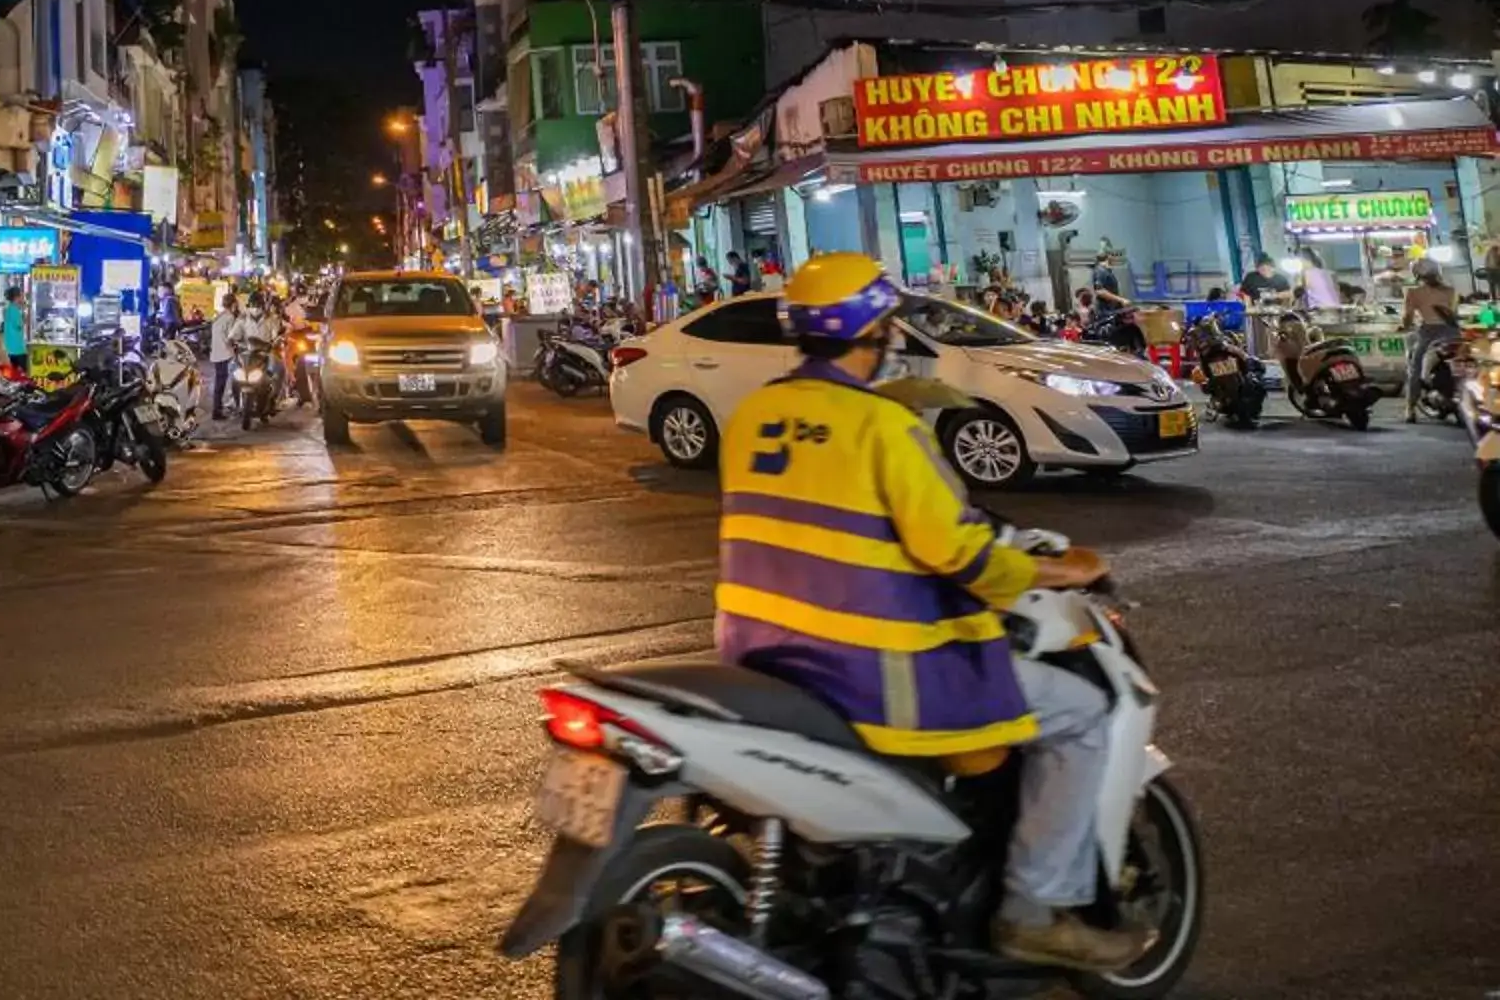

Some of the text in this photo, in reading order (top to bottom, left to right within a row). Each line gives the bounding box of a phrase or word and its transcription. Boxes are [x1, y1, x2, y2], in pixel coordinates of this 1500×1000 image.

[1130, 55, 1206, 88] 122
[864, 92, 1216, 143] KHÔNG CHI NHÁNH
[866, 158, 940, 182] HUYẾT
[1037, 156, 1083, 175] 122
[1108, 149, 1199, 169] KHÔNG
[1207, 147, 1253, 165] CHI
[1287, 194, 1350, 221] HUYẾT
